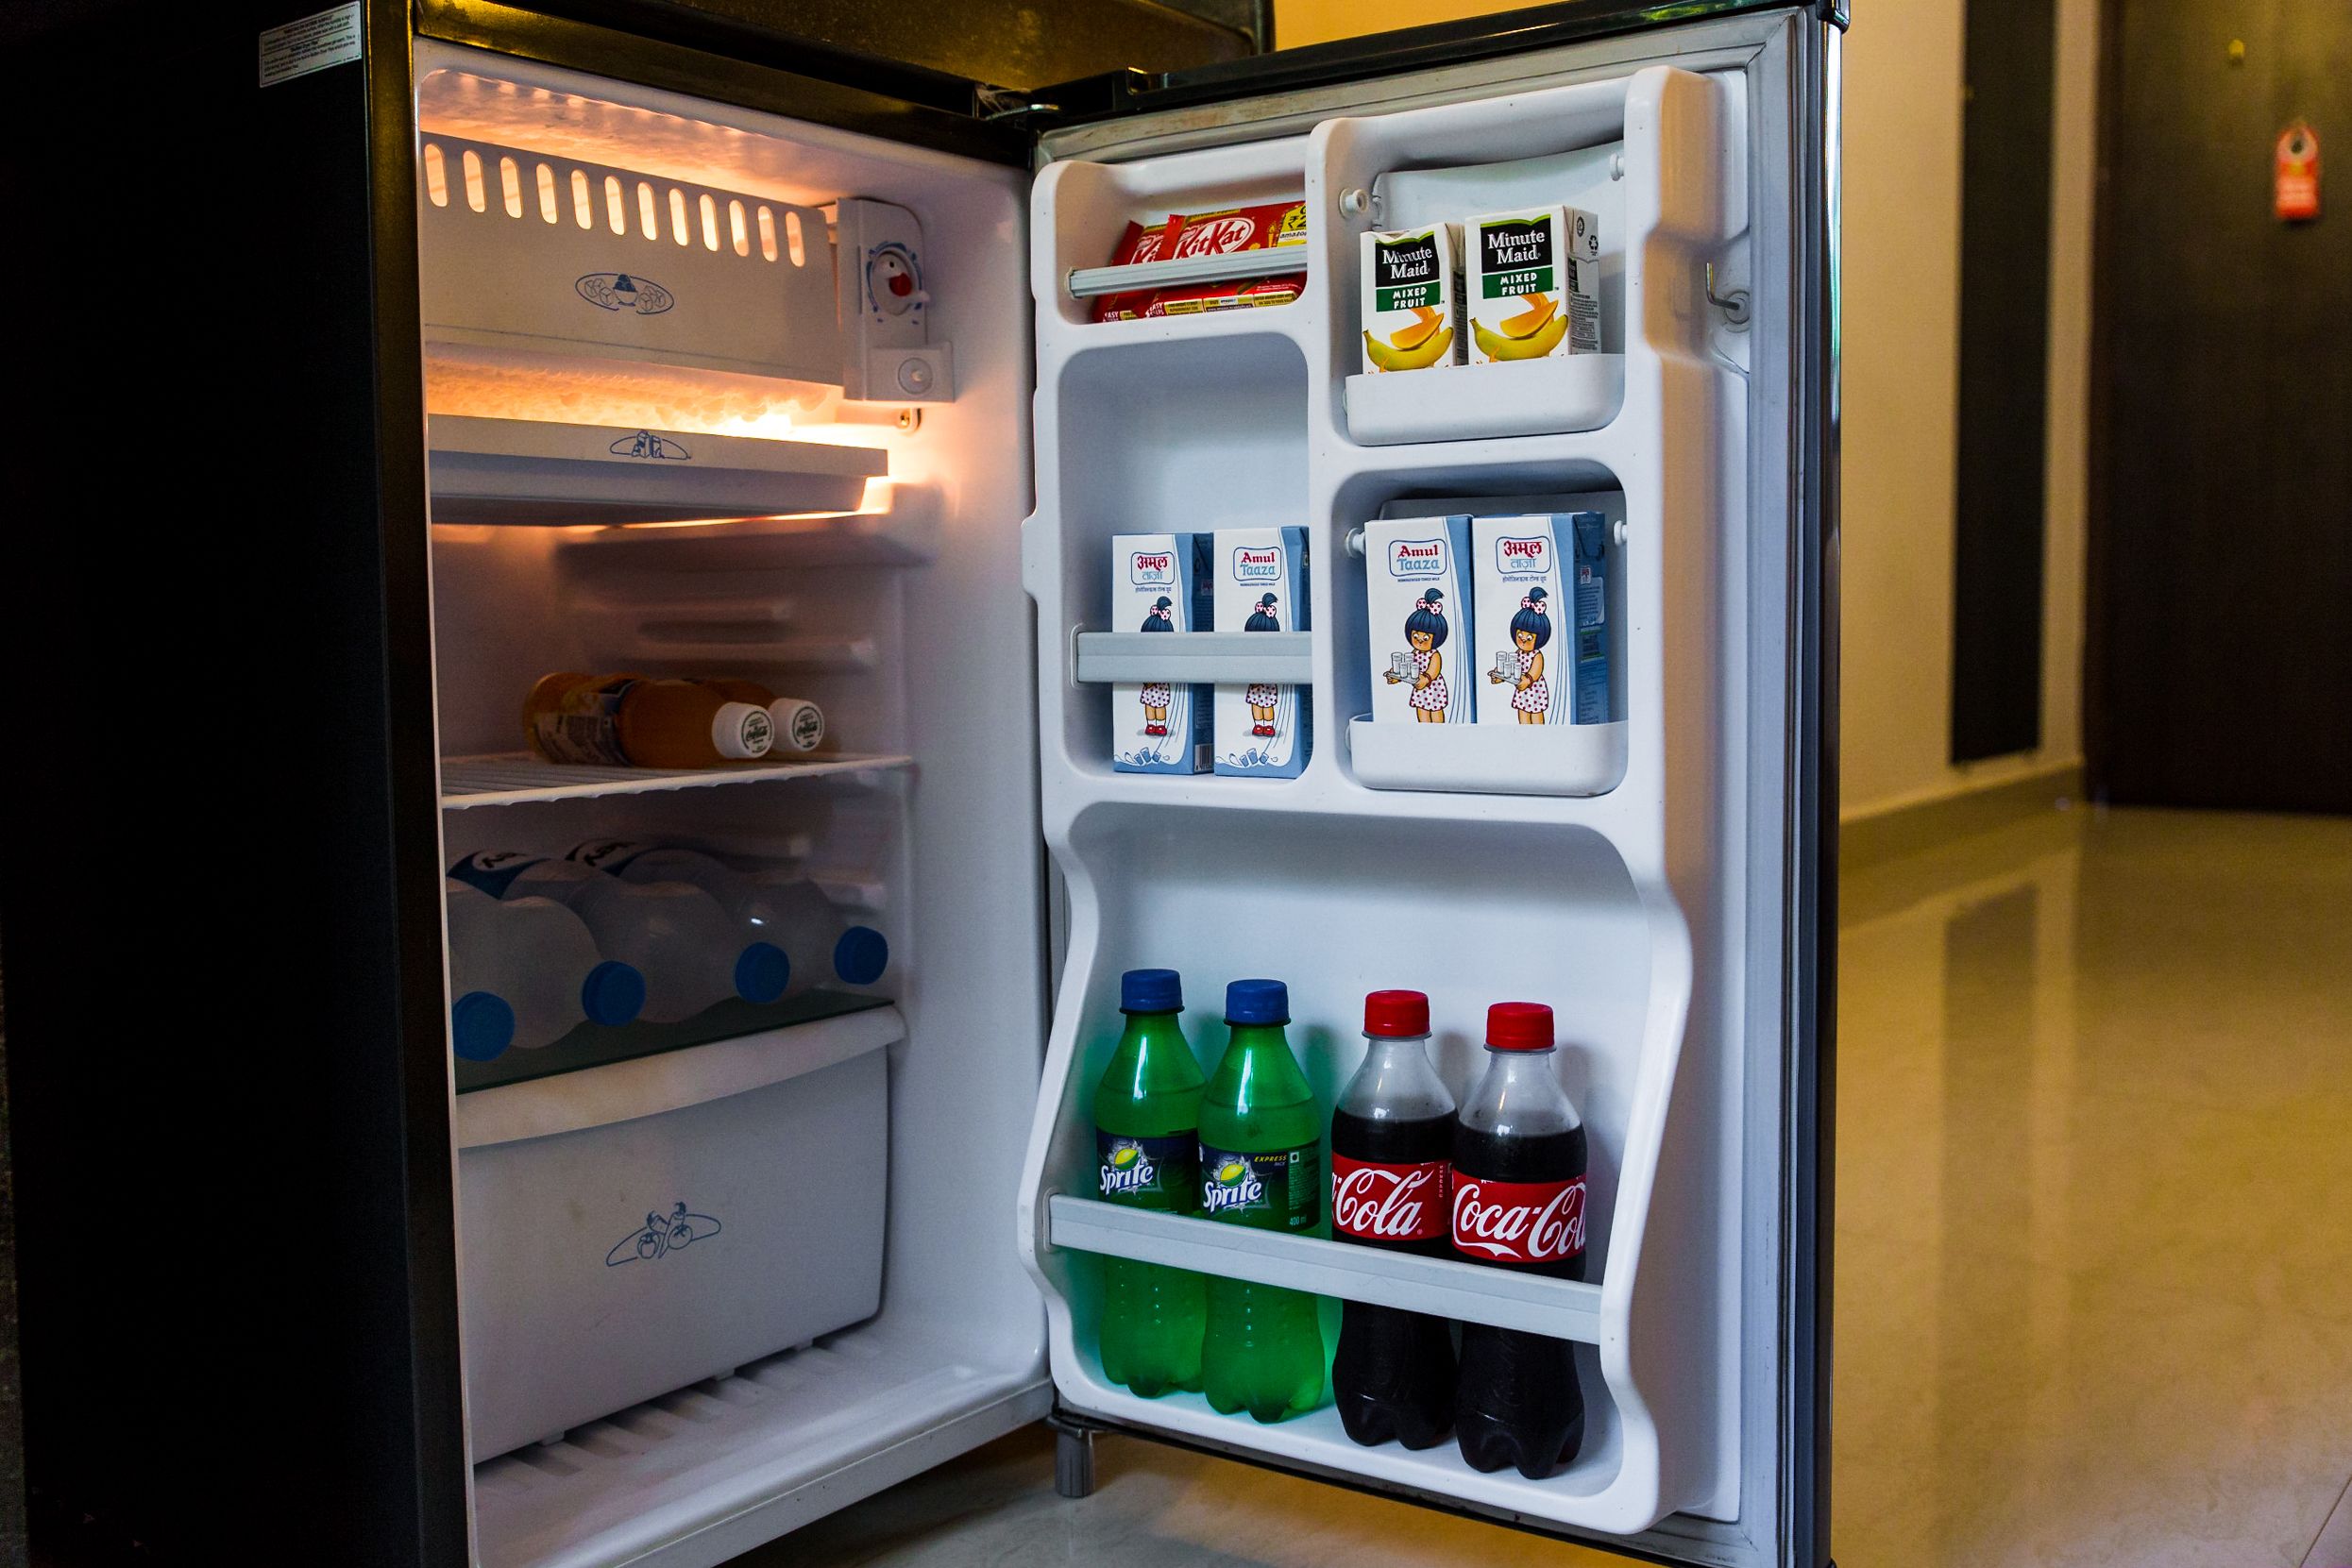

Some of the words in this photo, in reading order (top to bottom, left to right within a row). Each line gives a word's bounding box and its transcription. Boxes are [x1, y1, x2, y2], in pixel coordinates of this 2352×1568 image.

[1176, 220, 1246, 259] KitKat
[1488, 230, 1546, 250] Minute
[1382, 248, 1433, 264] Minute
[1497, 245, 1539, 264] Maid
[1390, 261, 1430, 279] Maid
[1499, 272, 1537, 285] MIXED
[1392, 287, 1427, 300] MIXED
[1501, 283, 1536, 295] FRUIT
[1394, 297, 1426, 310] FRUIT
[1241, 551, 1275, 564] Amul
[1397, 544, 1439, 558] Amul
[1503, 540, 1542, 559] अमूल
[1137, 555, 1168, 572] अमूल
[1240, 564, 1276, 576] Taaza
[1396, 558, 1440, 571] Taaza
[1099, 1159, 1154, 1195] Sprite
[1202, 1173, 1262, 1212] Sprite
